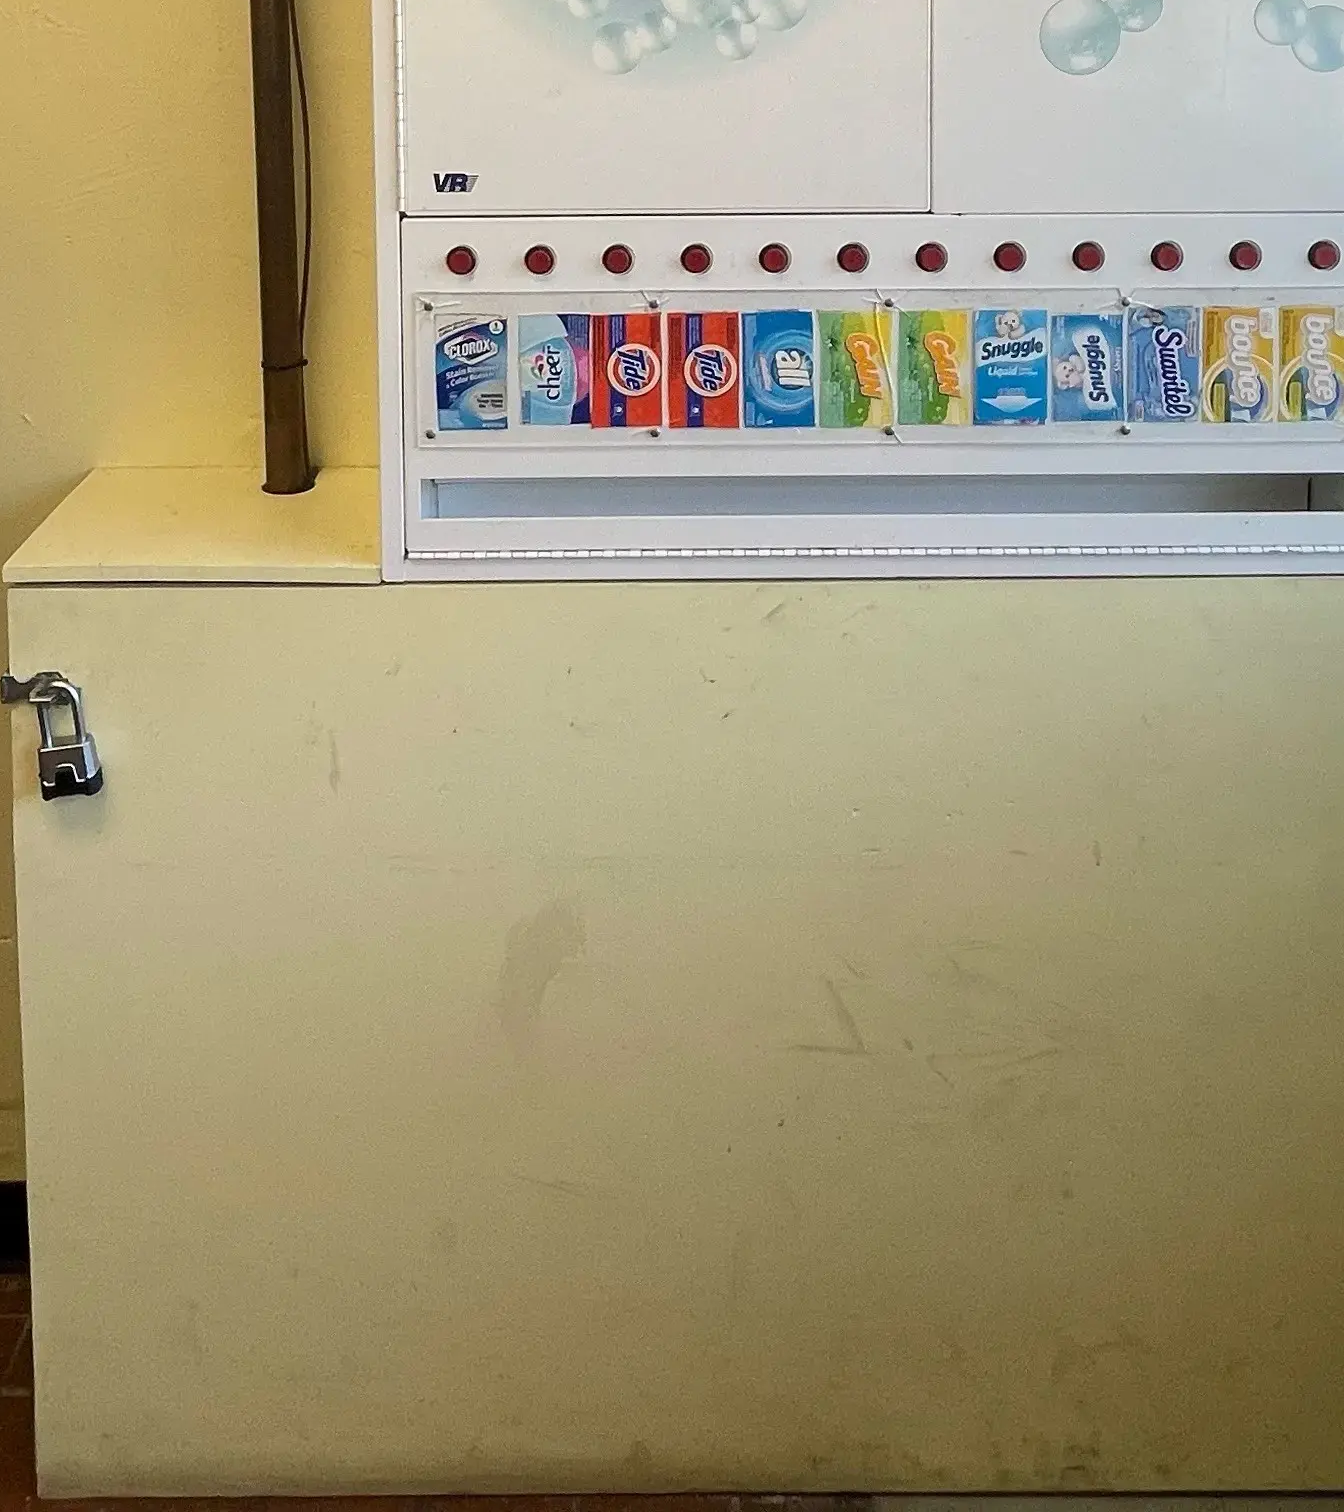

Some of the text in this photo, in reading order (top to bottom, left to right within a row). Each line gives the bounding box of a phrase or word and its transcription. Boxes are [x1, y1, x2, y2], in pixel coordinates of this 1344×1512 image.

[448, 338, 492, 359] CLOROX
[537, 344, 564, 401] cheer
[616, 348, 648, 392] Tide
[693, 349, 725, 392] Tide
[774, 349, 812, 388] all
[981, 337, 1044, 361] Snuggle
[1082, 334, 1109, 403] Snuggle
[1155, 327, 1192, 416] Suavitel
[1229, 317, 1258, 404] bounce
[1305, 316, 1334, 403] bounce
